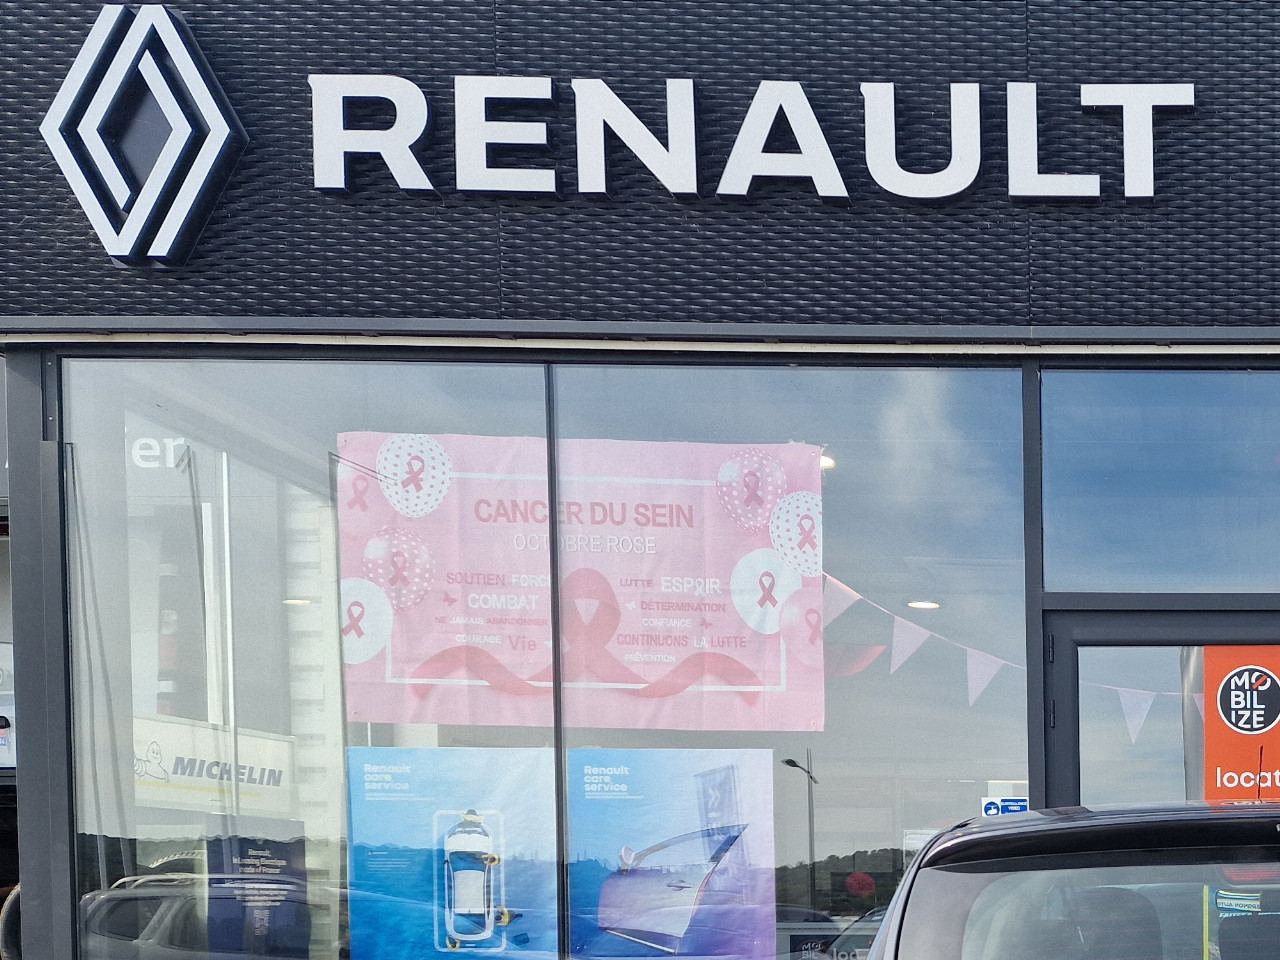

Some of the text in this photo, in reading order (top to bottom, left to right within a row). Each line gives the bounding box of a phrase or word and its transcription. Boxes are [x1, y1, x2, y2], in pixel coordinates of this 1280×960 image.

[308, 73, 1196, 199] RENAULT
[474, 498, 694, 528] CANCER DU SEIN
[607, 535, 658, 554] ROSE
[446, 572, 550, 587] SOUTIEN FORC
[620, 578, 653, 588] LUTTE
[467, 593, 540, 610] COMBAT
[450, 617, 485, 625] JAMAIS
[642, 617, 692, 628] CONFIANCE
[455, 633, 537, 651] COURAGE Vie
[616, 633, 747, 648] CONTINUONS LA LUTTE
[172, 756, 283, 787] MICHELIN
[363, 763, 411, 774] Renault
[583, 765, 630, 775] Renault
[583, 774, 611, 783] care
[584, 782, 628, 792] service
